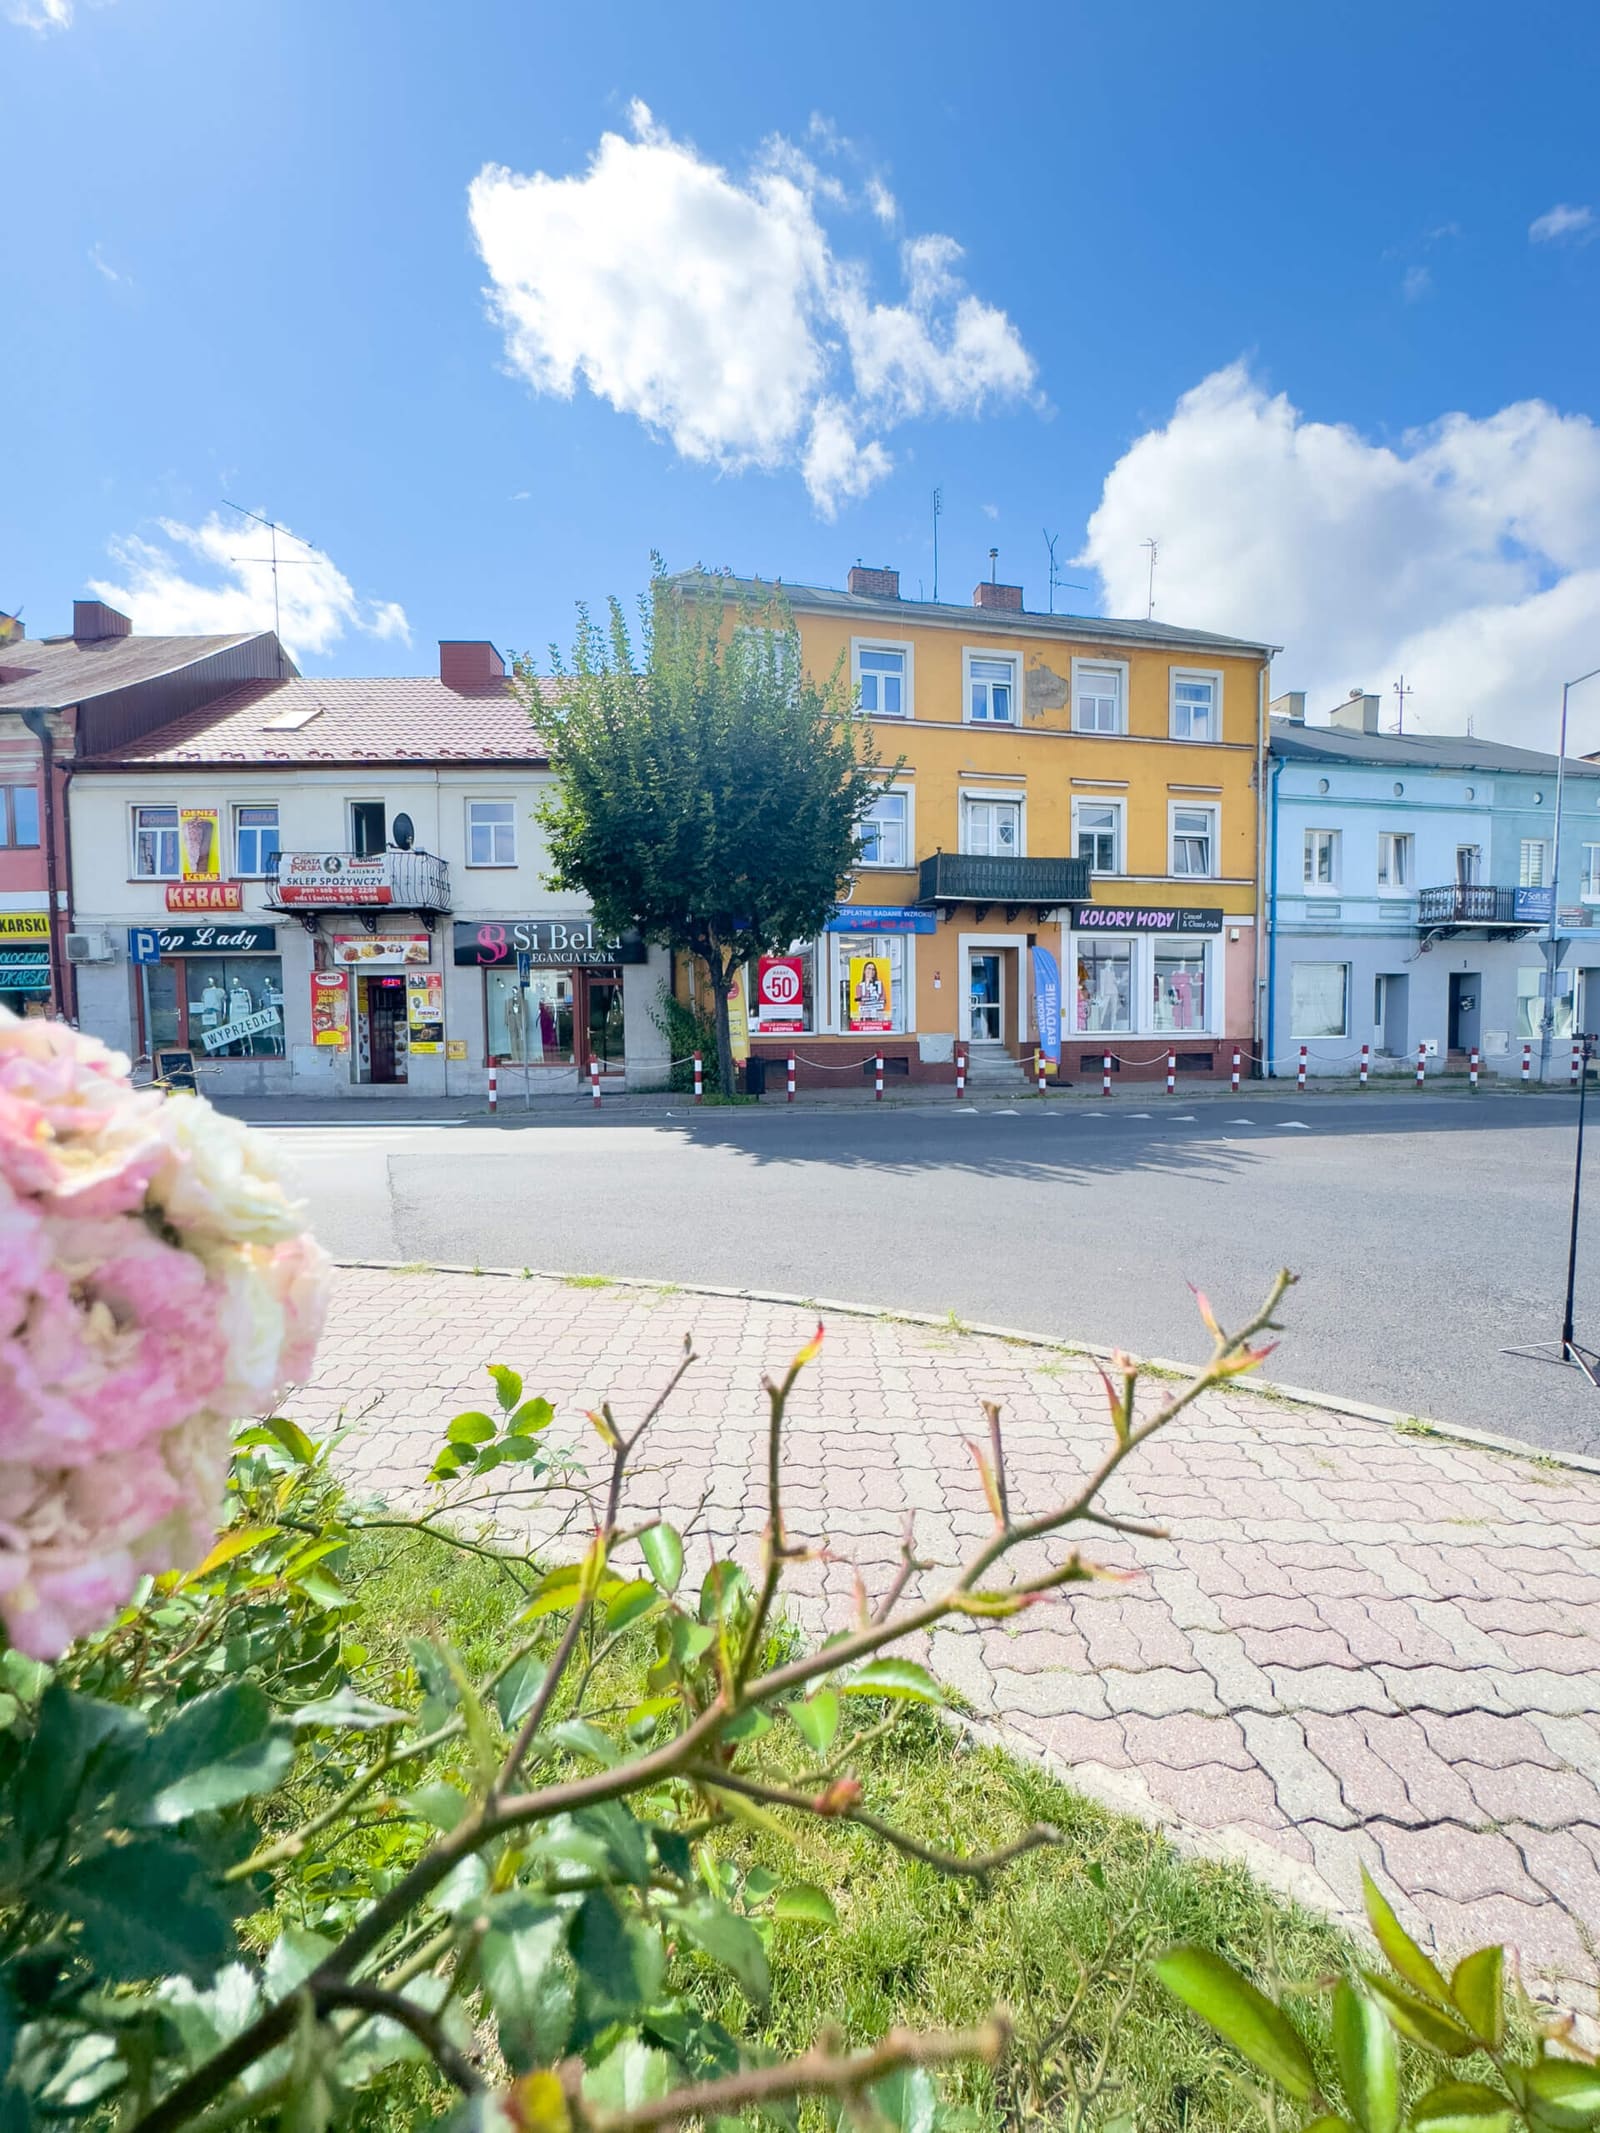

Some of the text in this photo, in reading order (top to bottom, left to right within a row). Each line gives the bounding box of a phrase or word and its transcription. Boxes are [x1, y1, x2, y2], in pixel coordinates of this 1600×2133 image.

[287, 875, 383, 886] SKLEP SPOŻYWCZY
[168, 887, 238, 907] KEBAB
[0, 918, 47, 933] KARSKI
[1079, 909, 1175, 928] KOLORY MODY
[137, 933, 154, 960] P
[192, 928, 257, 950] Lady
[513, 923, 623, 951] Si Bela
[529, 952, 581, 963] EGANCJA
[588, 952, 615, 963] SZYK
[207, 1010, 275, 1045] WYPRZEDAŻ
